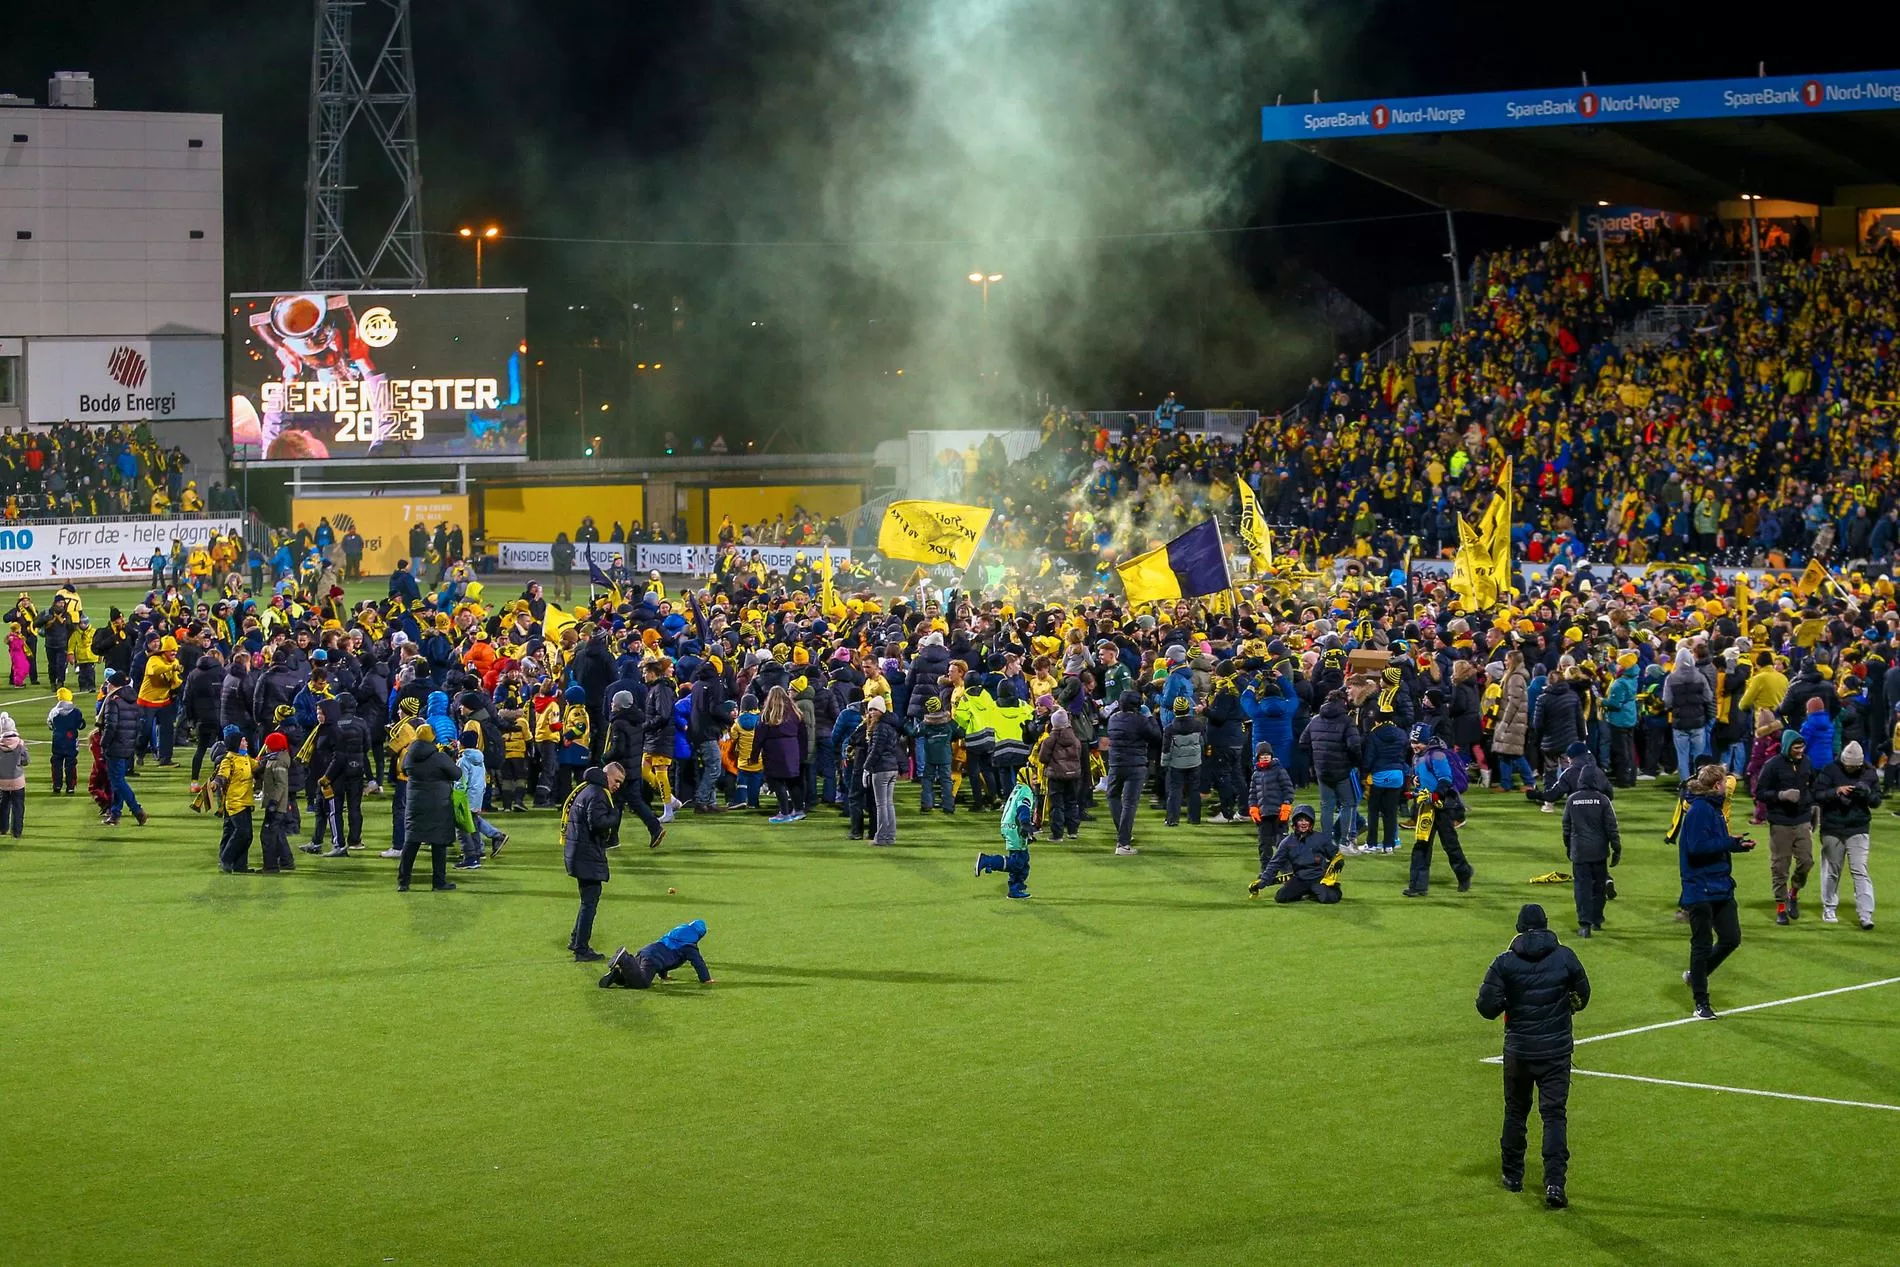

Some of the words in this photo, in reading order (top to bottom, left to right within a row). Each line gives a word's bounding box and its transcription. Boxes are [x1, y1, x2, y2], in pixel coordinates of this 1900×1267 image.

[1724, 88, 1799, 108] SpareBank
[1807, 85, 1816, 101] 1
[1826, 83, 1900, 101] Nord-Norg
[1506, 99, 1576, 119] SpareBank
[1583, 97, 1592, 113] 1
[1601, 95, 1680, 113] Nord-Norge
[1304, 112, 1369, 131] SpareBank
[1375, 109, 1384, 125] 1
[1392, 107, 1465, 124] Nord-Norge
[80, 393, 120, 413] Bodø
[127, 392, 176, 415] Energi
[261, 378, 498, 413] SERIEMESTER
[335, 410, 424, 442] 2023
[0, 529, 33, 550] no
[58, 527, 91, 546] Førr
[95, 525, 119, 544] dæ
[133, 524, 165, 542] hele
[0, 560, 41, 573] NSIDER
[61, 557, 111, 570] INSIDER
[510, 550, 548, 562] INSIDER
[580, 551, 613, 562] ISIDE
[650, 553, 682, 564] INSIDE
[762, 555, 792, 566] SIDER
